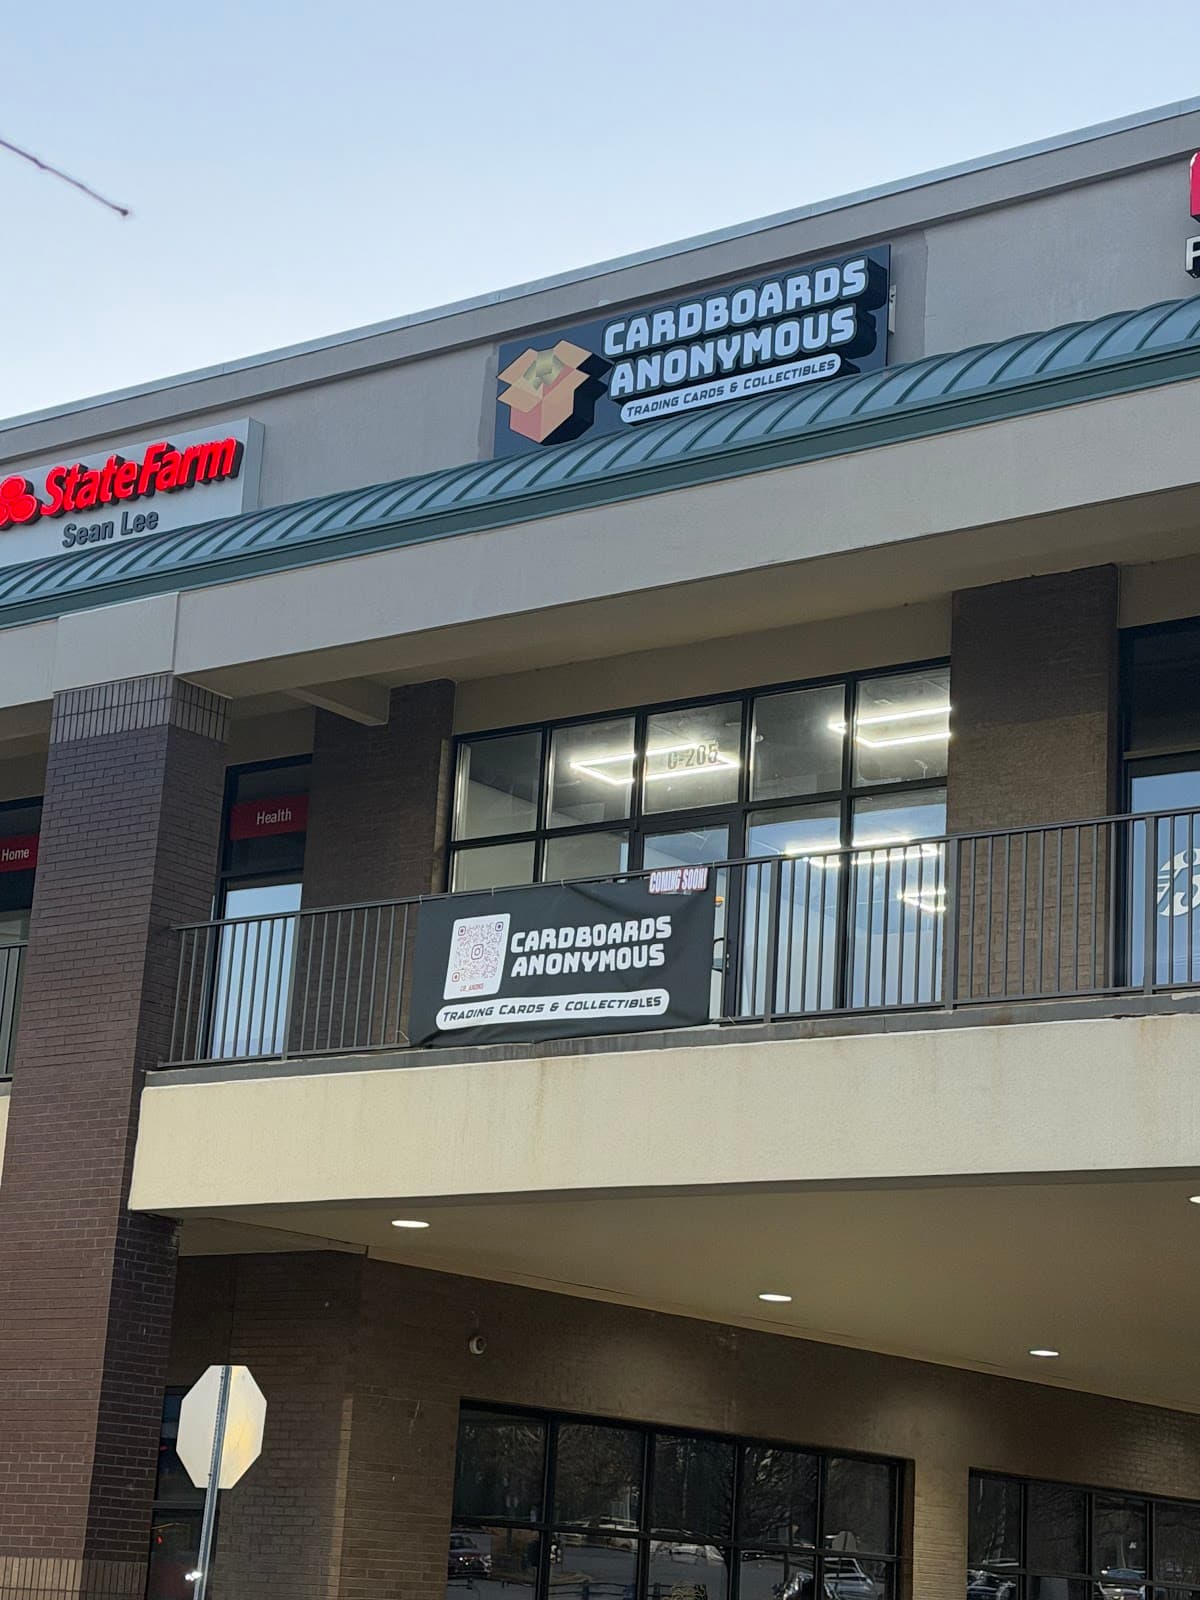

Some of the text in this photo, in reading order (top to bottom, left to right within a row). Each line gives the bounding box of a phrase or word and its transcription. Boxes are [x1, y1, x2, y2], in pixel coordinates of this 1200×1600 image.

[604, 259, 867, 357] CARDBOARDS
[610, 307, 856, 398] ANONYMOUS
[626, 359, 836, 418] TRADING CARDS & COLLECTIBLES
[62, 510, 160, 549] Sean Lee
[256, 807, 293, 826] Health
[1, 848, 30, 862] Home
[649, 869, 682, 894] COMING
[510, 916, 672, 954] CARDBOARDS
[510, 943, 665, 978] ANONYMOUS
[443, 996, 663, 1023] TRADING CARDS & COLLECTIBLES
